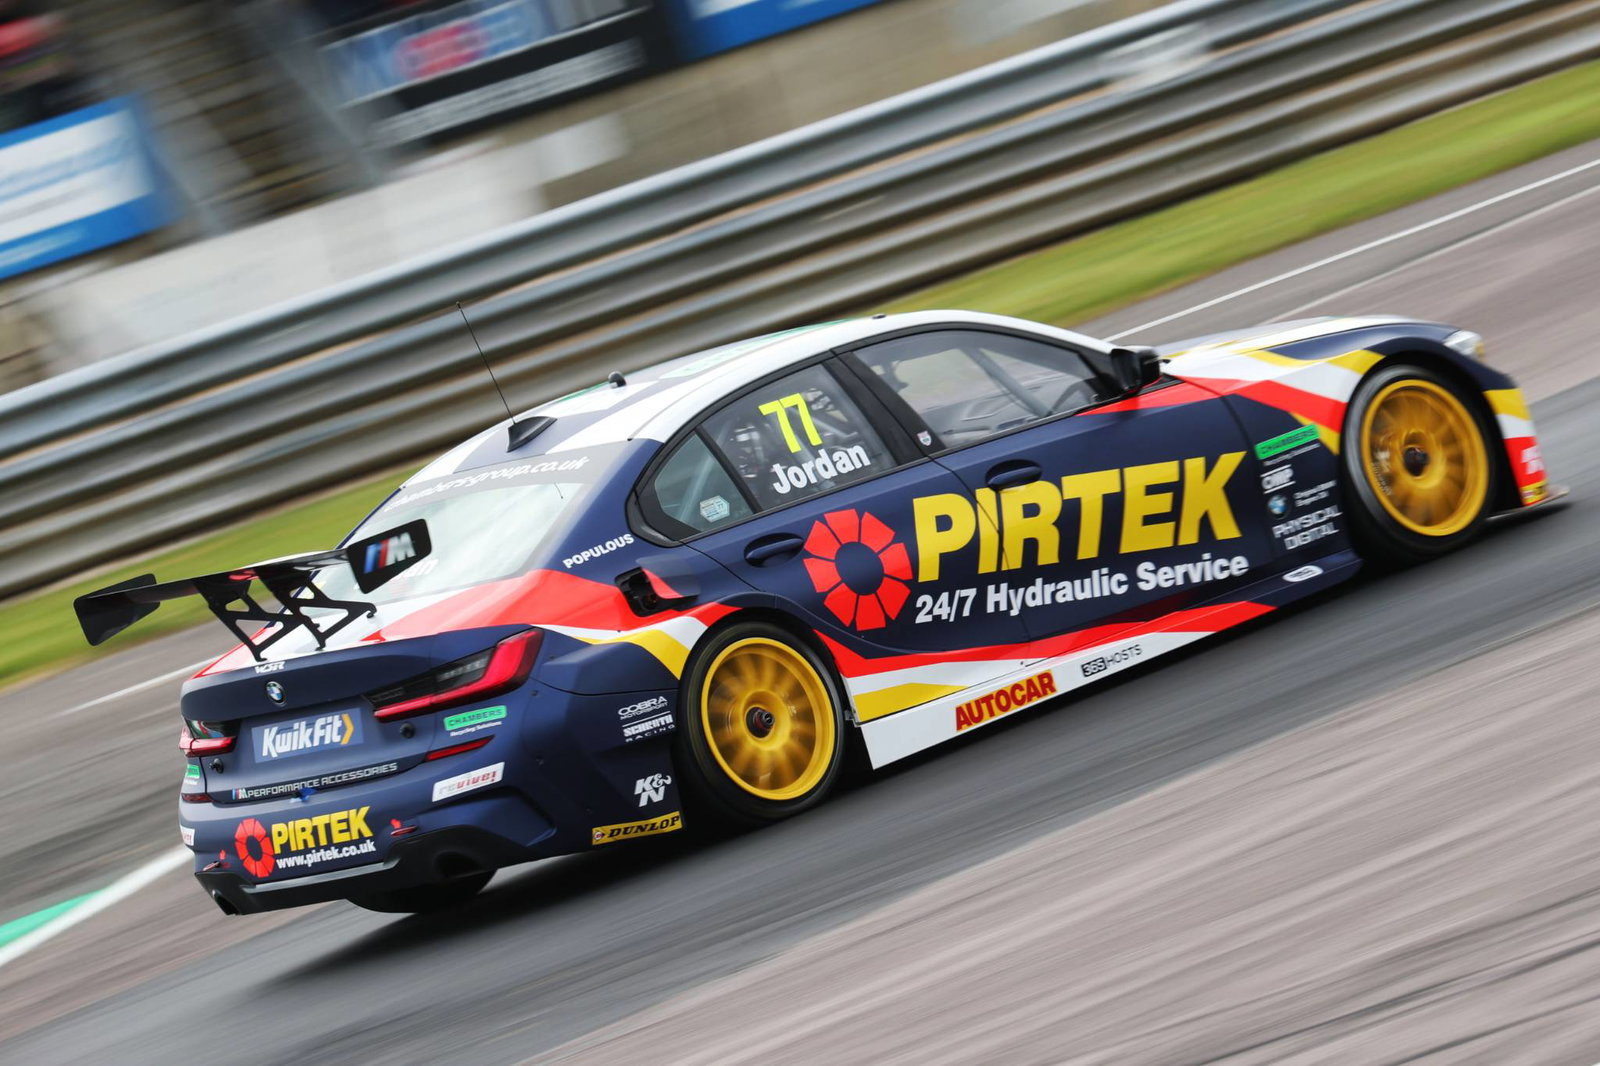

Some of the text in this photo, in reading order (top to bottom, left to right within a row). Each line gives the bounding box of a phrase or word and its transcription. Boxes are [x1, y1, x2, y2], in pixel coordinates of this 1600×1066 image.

[758, 393, 823, 454] 77
[772, 443, 871, 494] Jordan
[912, 450, 1248, 583] PIRTEK
[562, 533, 635, 569] POPULOUS
[914, 552, 1250, 624] 24/7 Hydraulic Service
[618, 695, 668, 716] COBRA
[955, 670, 1057, 732] AUTOCAR
[625, 723, 675, 742] RACING
[247, 778, 320, 798] PERFORMANCE
[321, 762, 398, 786] ACCESSORIES
[271, 805, 374, 855] PIRTEK
[607, 815, 680, 838] DUNLOP
[276, 840, 376, 869] www.pirtek.co.uk
